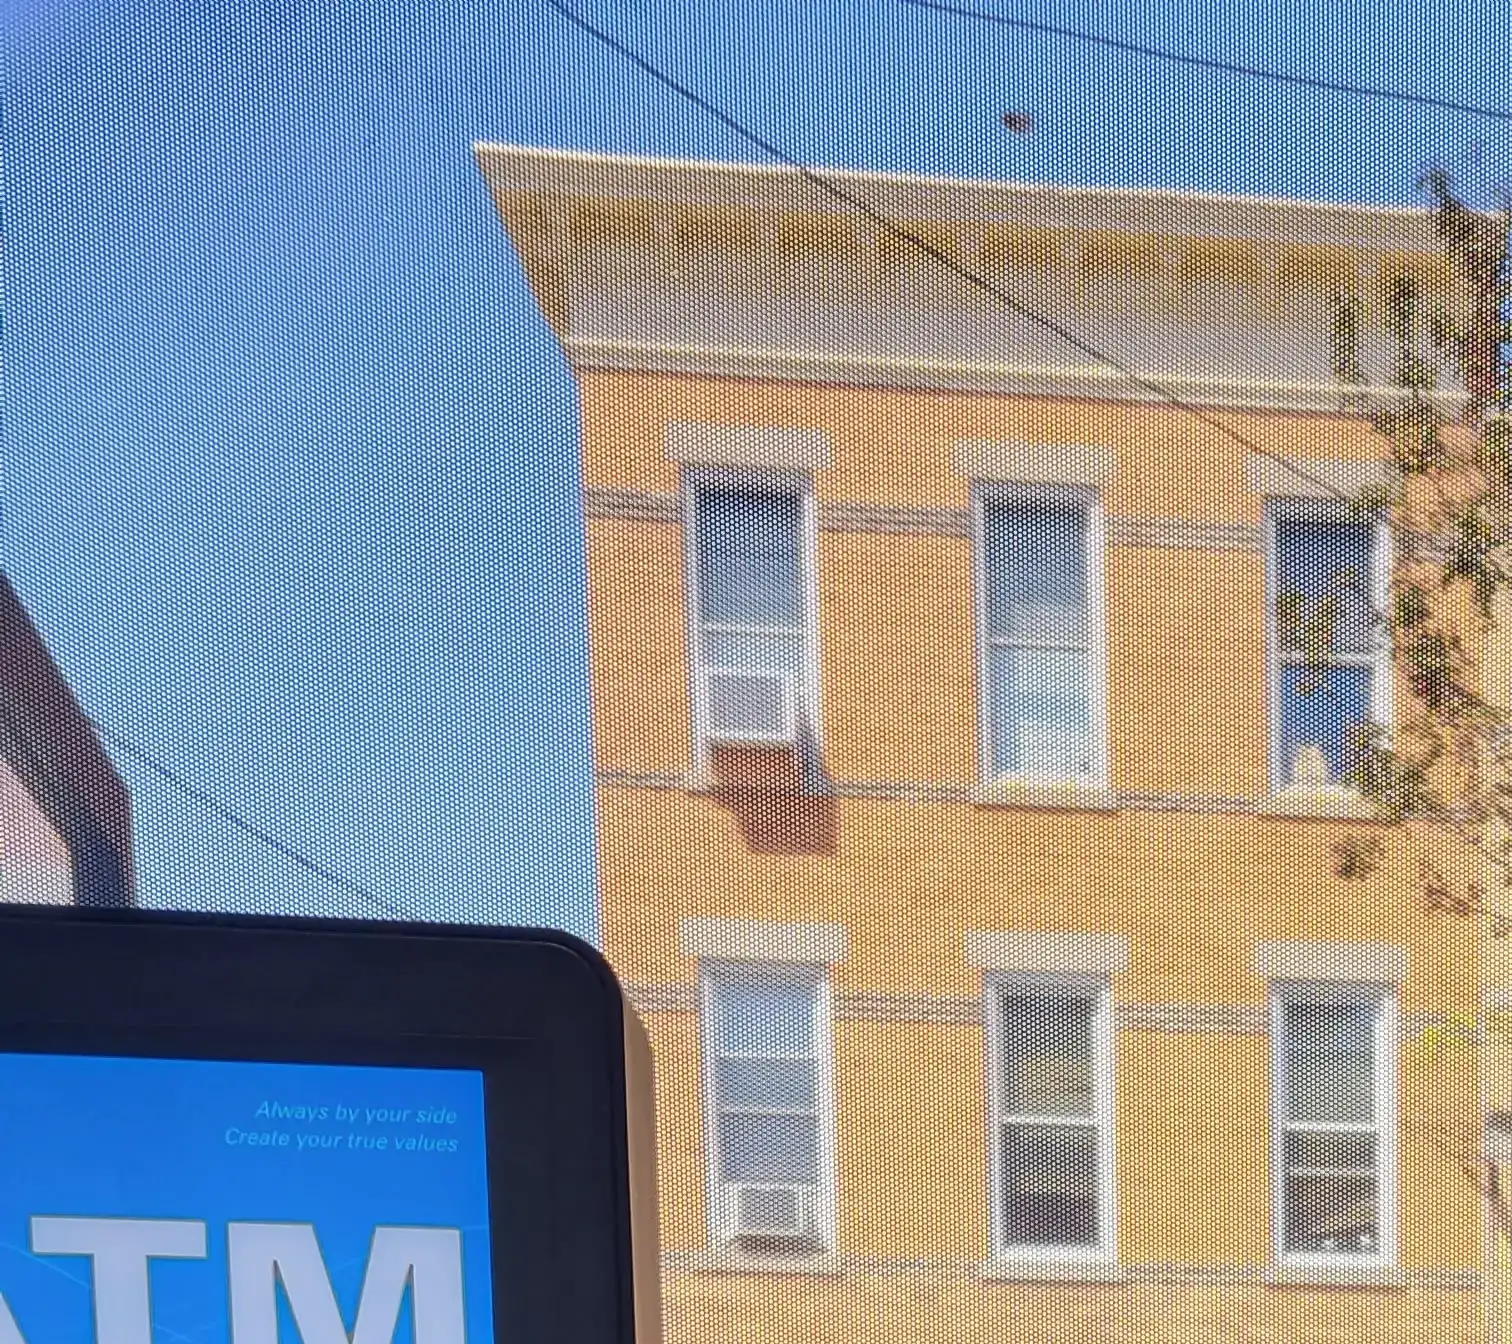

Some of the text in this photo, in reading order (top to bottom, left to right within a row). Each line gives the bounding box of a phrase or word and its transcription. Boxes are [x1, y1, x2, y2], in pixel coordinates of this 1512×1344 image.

[254, 1100, 458, 1125] Always by your side
[224, 1127, 459, 1152] Create your true values
